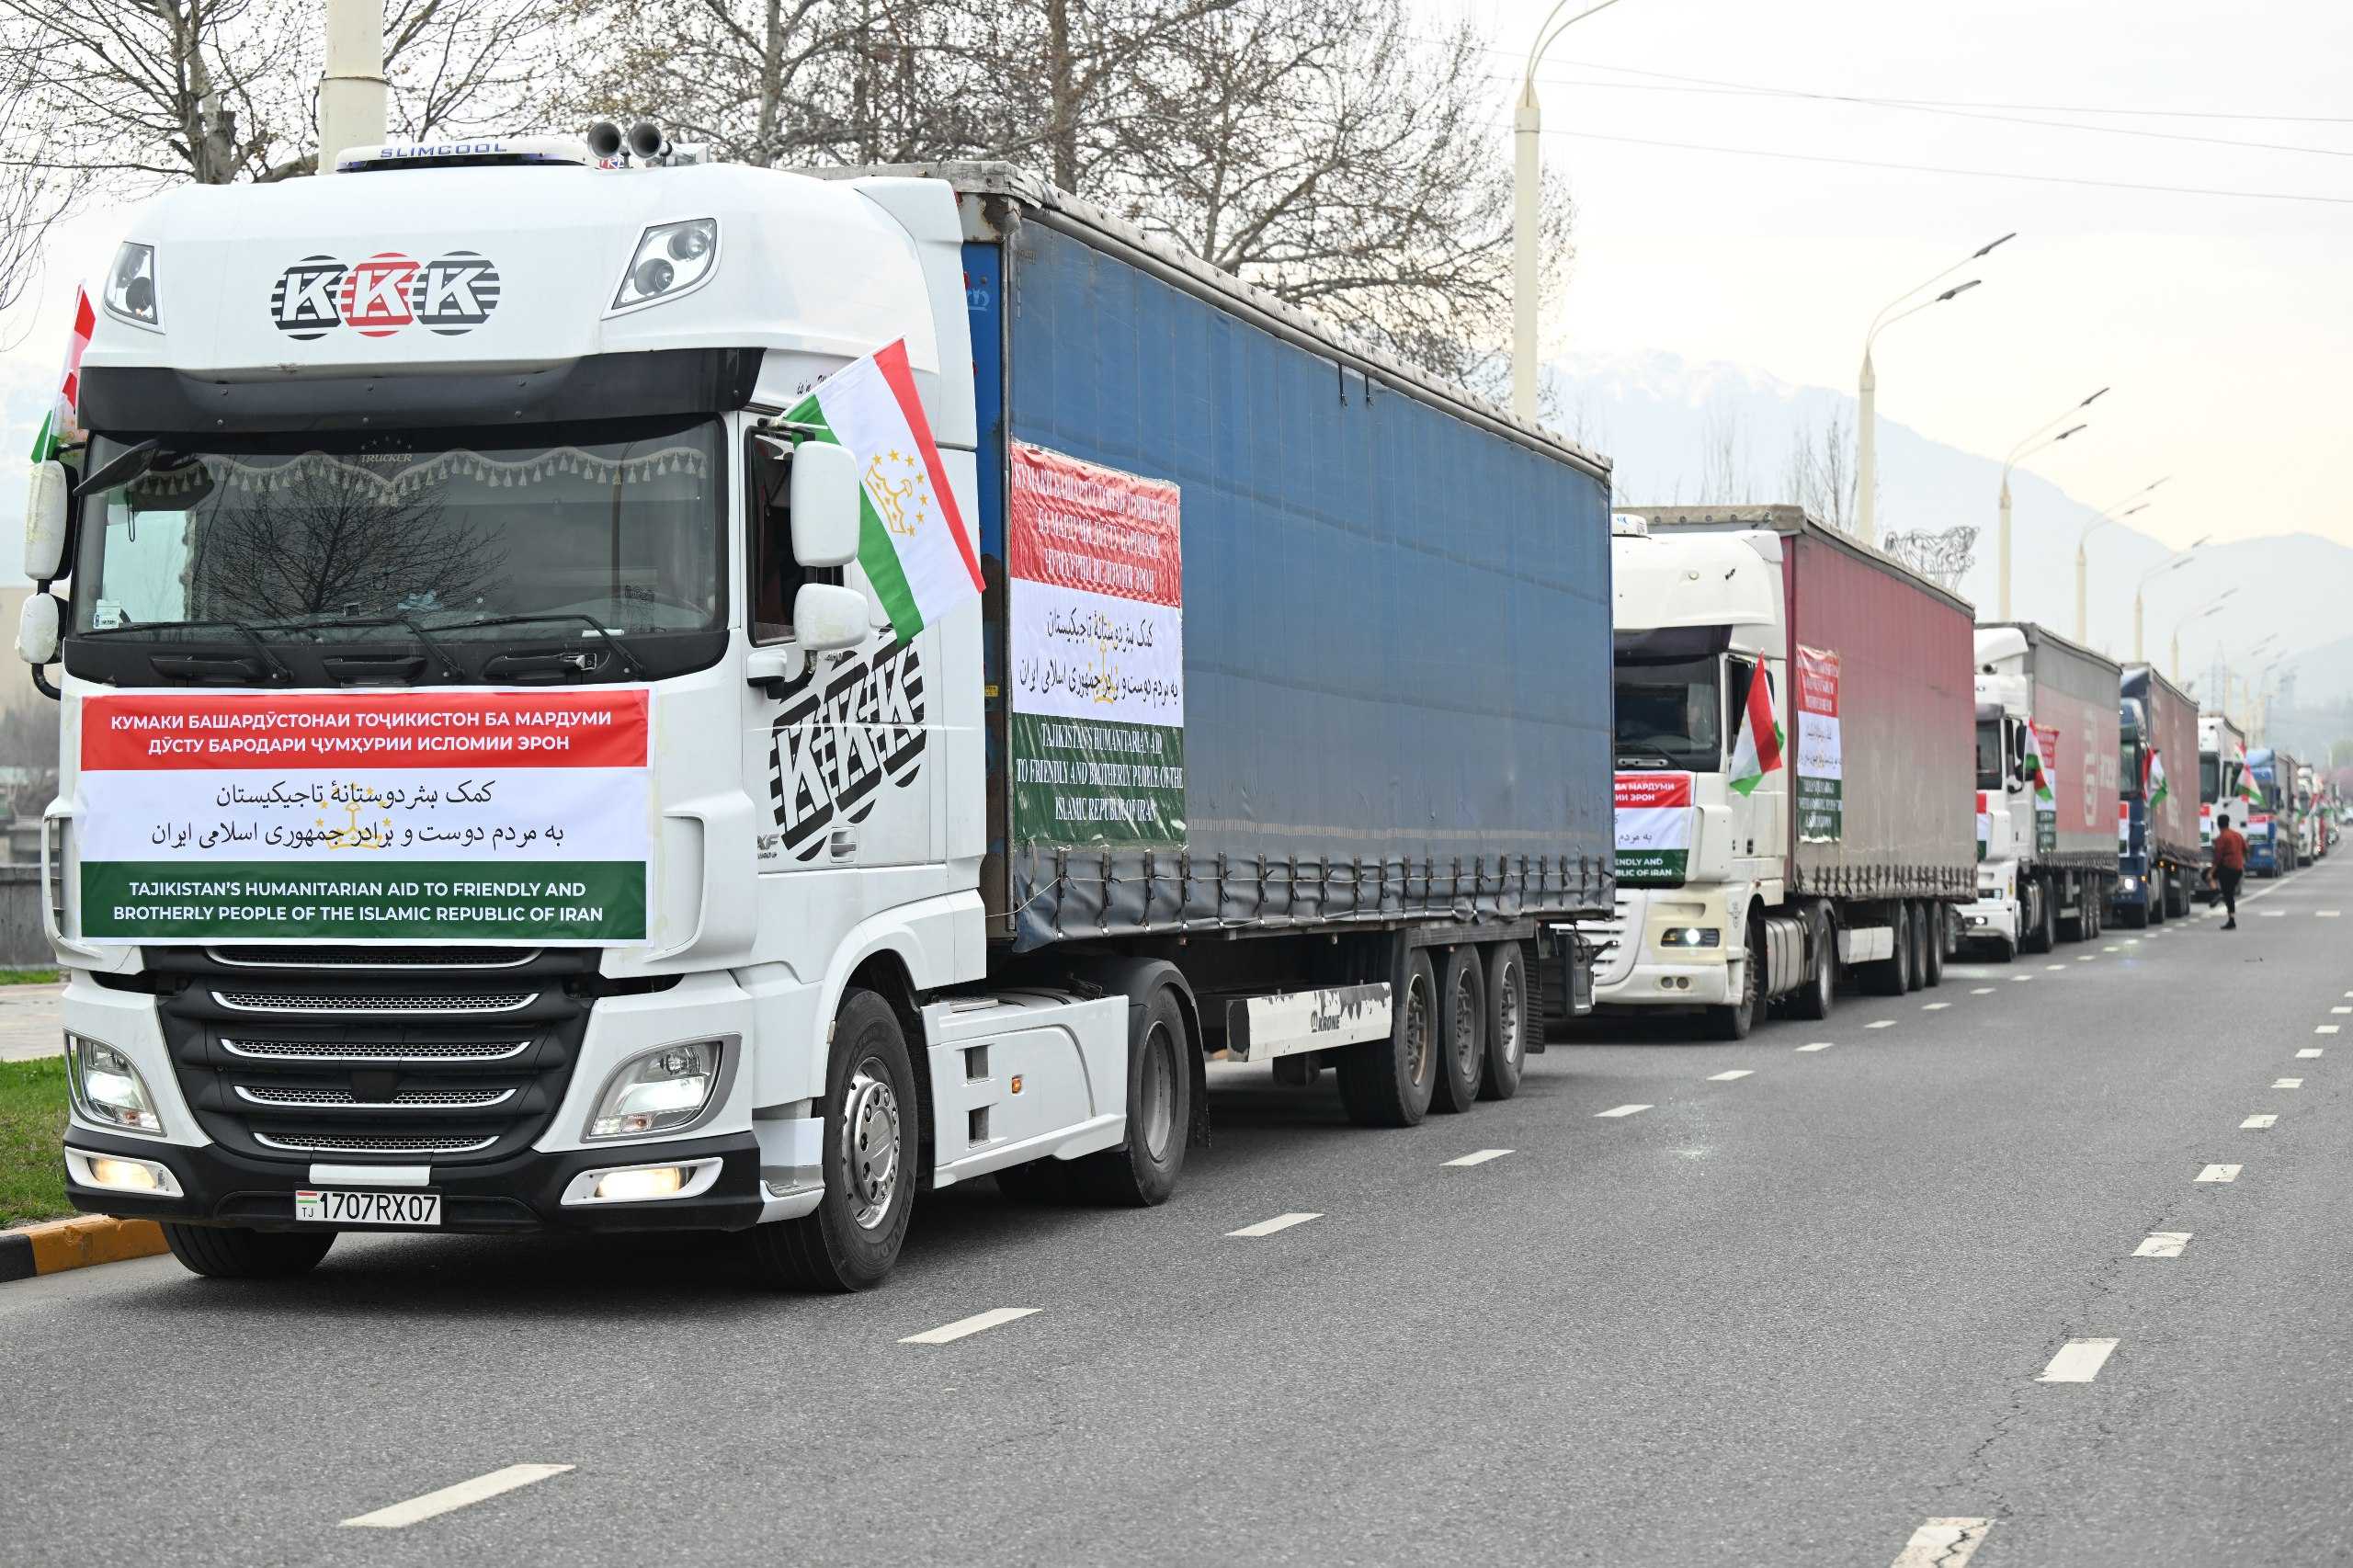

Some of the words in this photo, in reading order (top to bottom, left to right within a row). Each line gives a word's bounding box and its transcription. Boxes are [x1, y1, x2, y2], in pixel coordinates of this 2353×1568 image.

[381, 142, 507, 158] SLIMCOOL
[360, 454, 412, 463] TRUCKER
[111, 714, 184, 730] КУМАКИ
[188, 711, 350, 731] БАШАРДӮСТОНАИ
[355, 711, 480, 730] ТОҶИКИСТОН
[484, 711, 508, 727] БА
[515, 710, 612, 728] МАРДУМИ
[148, 736, 204, 756] ДӮСТУ
[209, 737, 306, 755] БАРОДАРИ
[311, 736, 413, 755] ҶУМҲУРИИ
[417, 736, 513, 752] ИСЛОМИИ
[517, 735, 570, 751] ЭРОН
[1016, 758, 1029, 782] TO
[1029, 758, 1069, 784] FRIENDLY
[1070, 761, 1088, 785] AND
[1088, 761, 1131, 786] BROTHERLY
[1132, 765, 1160, 788] PEOPLE
[446, 779, 496, 803] کمک
[1628, 783, 1676, 792] МАРДУМИ
[1630, 793, 1655, 801] ЭРОН
[1055, 797, 1087, 821] ISLAMIC
[1088, 797, 1127, 822] REPUBLIC
[152, 821, 192, 849] ایران
[199, 821, 258, 849] اسلامی
[265, 824, 345, 849] جمهوری
[350, 821, 394, 848] برادر
[400, 826, 414, 847] و
[418, 825, 485, 847] دوست
[492, 825, 537, 852] مردم
[544, 824, 564, 847] به
[1643, 858, 1664, 866] AND
[1636, 869, 1648, 877] OF
[1650, 869, 1672, 877] IRAN
[245, 881, 383, 897] HUMANITARIAN
[387, 882, 419, 897] AID
[423, 882, 449, 897] TO
[453, 882, 540, 897] FRIENDLY
[544, 882, 586, 897] AND
[113, 906, 214, 921] BROTHERLY
[219, 906, 287, 921] PEOPLE
[291, 906, 316, 921] OF
[319, 906, 355, 921] THE
[359, 906, 431, 922] ISLAMIC
[436, 906, 526, 922] REPUBLIC
[529, 907, 555, 922] OF
[559, 907, 604, 922] IRAN
[1318, 1014, 1341, 1032] KRONE
[301, 1207, 314, 1218] TJ
[319, 1192, 438, 1222] 1707RX07
